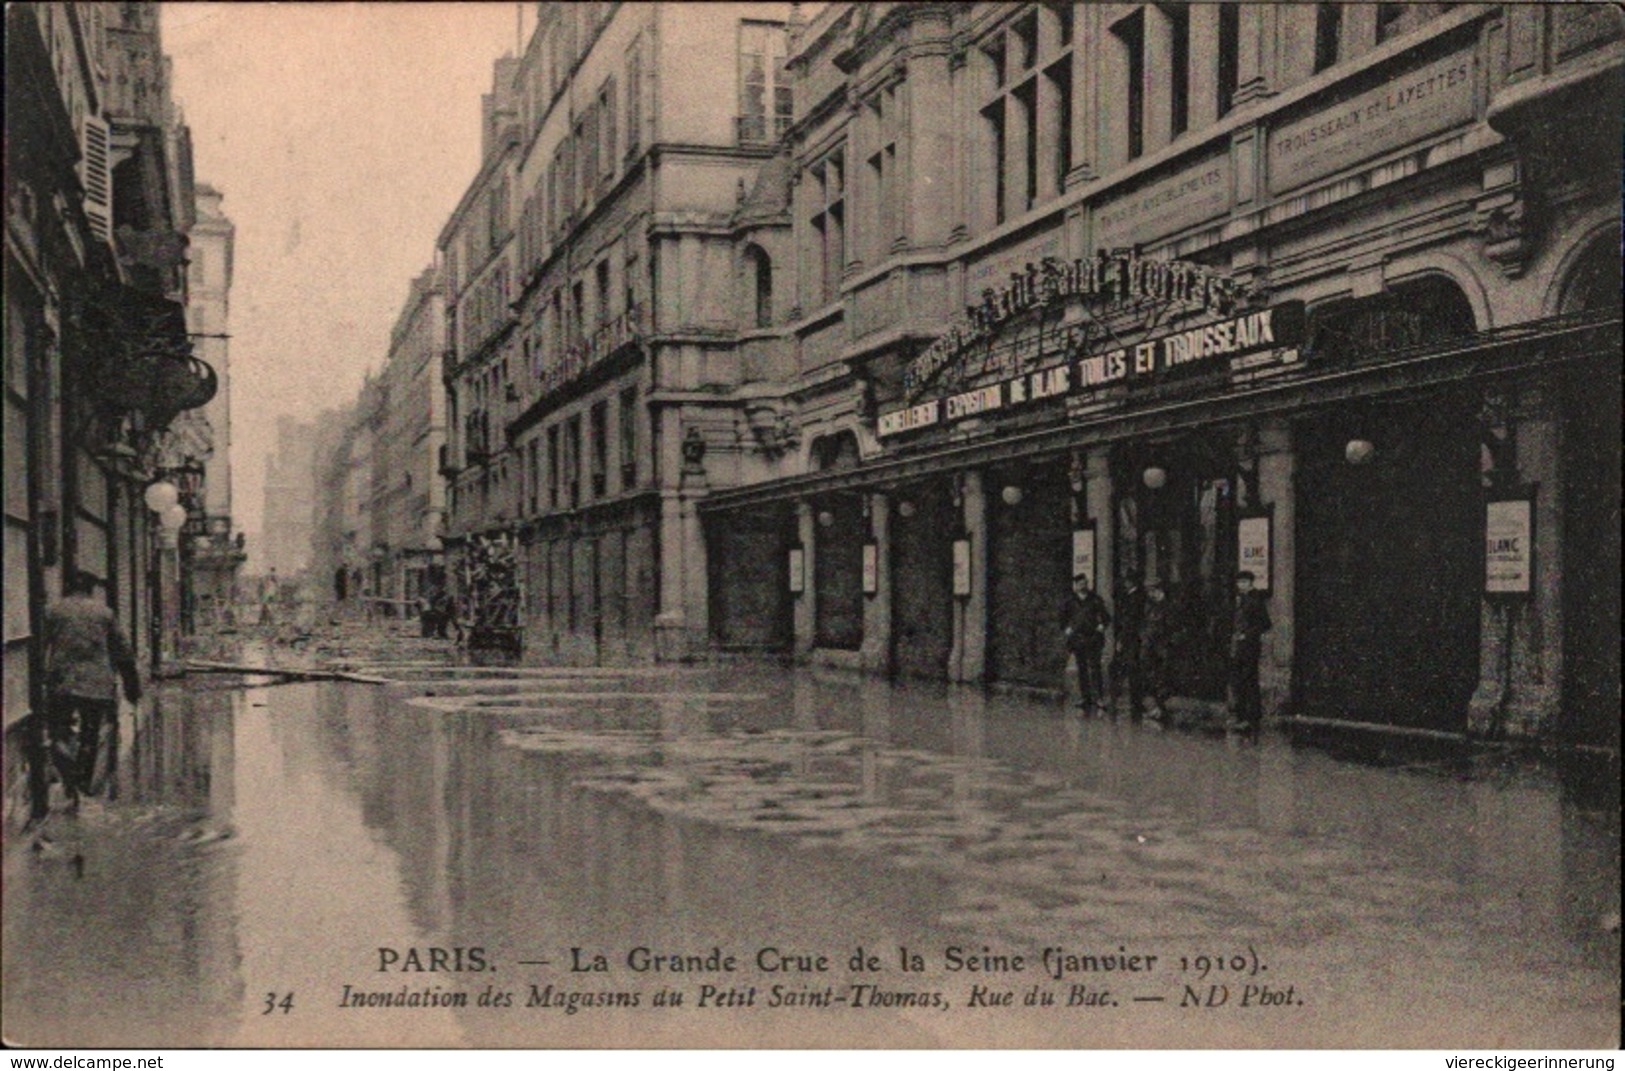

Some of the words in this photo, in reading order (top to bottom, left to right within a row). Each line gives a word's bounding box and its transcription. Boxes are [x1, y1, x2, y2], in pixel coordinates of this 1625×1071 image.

[1386, 64, 1468, 111] LAYETTES
[1078, 349, 1127, 387] TOILES
[1135, 341, 1156, 374] ET
[1163, 309, 1275, 368] TROUSSEAUX
